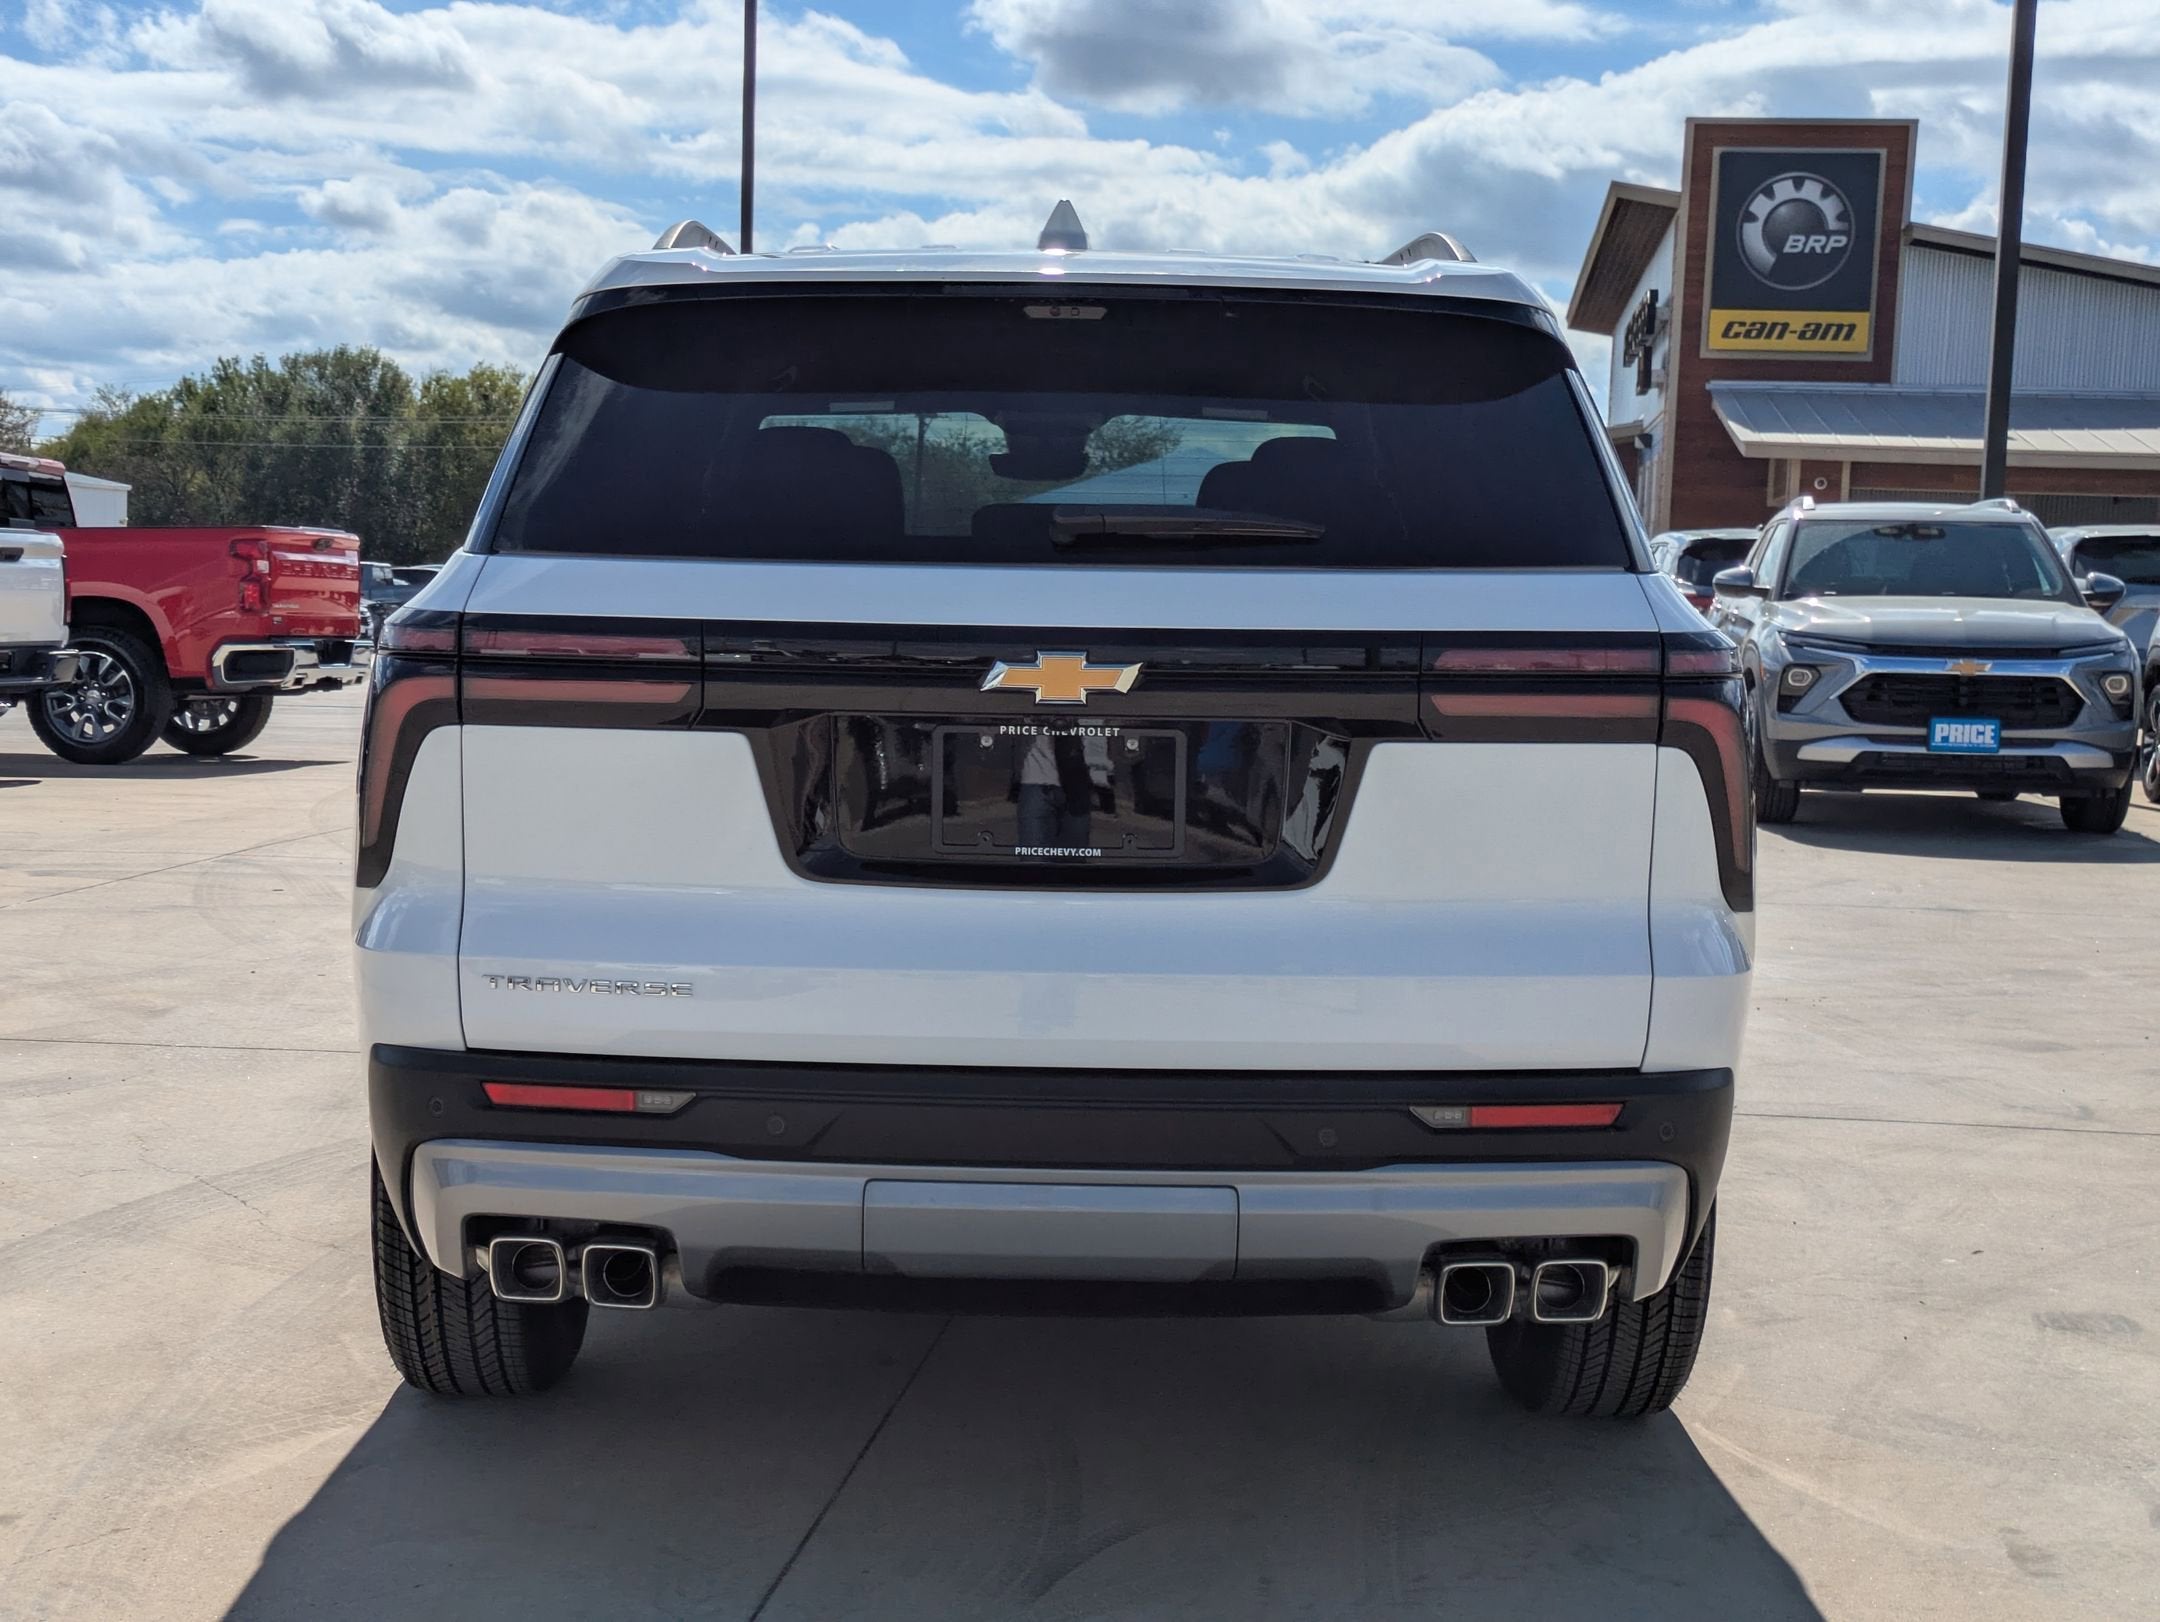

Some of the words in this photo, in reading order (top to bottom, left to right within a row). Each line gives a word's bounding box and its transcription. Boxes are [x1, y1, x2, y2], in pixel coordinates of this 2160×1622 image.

[1783, 234, 1848, 254] BRP
[1721, 320, 1857, 341] can-am
[1000, 725, 1038, 736] PRICE
[1934, 723, 1996, 744] PRICE
[1015, 847, 1102, 857] PRICECHEVY.COM
[482, 973, 693, 997] TRAVERSE
